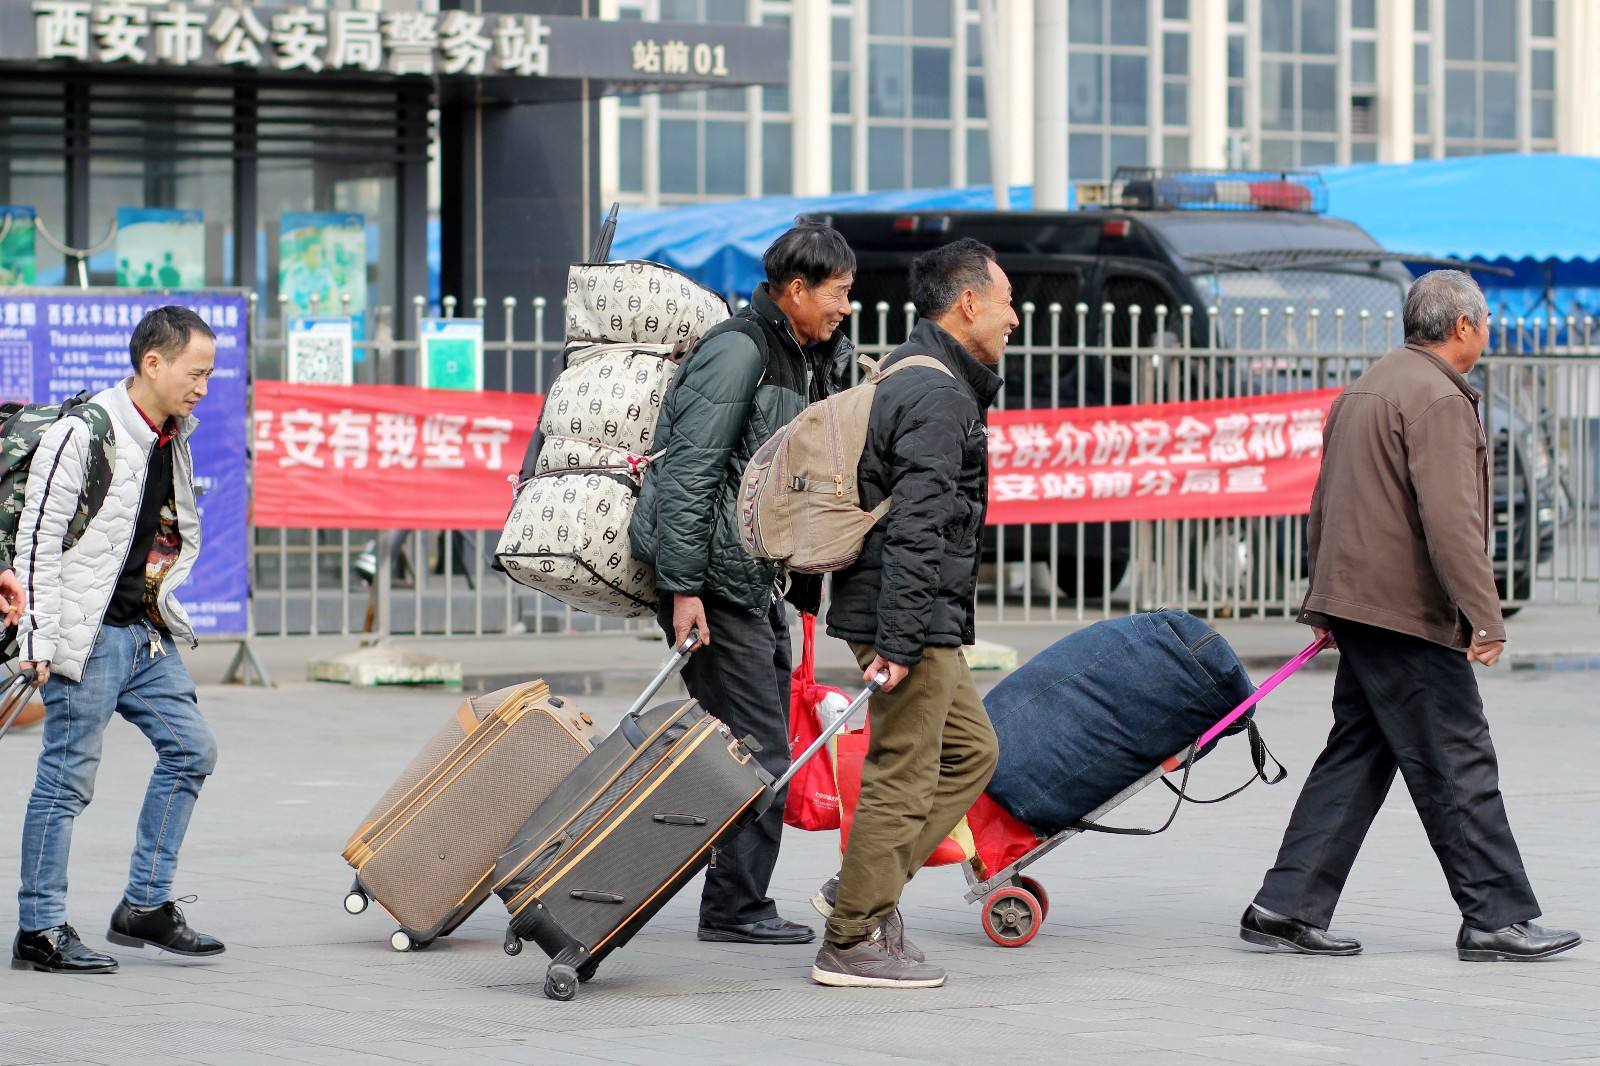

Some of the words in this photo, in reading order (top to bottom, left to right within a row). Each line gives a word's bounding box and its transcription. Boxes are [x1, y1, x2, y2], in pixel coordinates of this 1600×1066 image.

[33, 3, 551, 76] 西安市公安局警务站
[632, 39, 690, 74] 站前
[694, 43, 728, 75] 01
